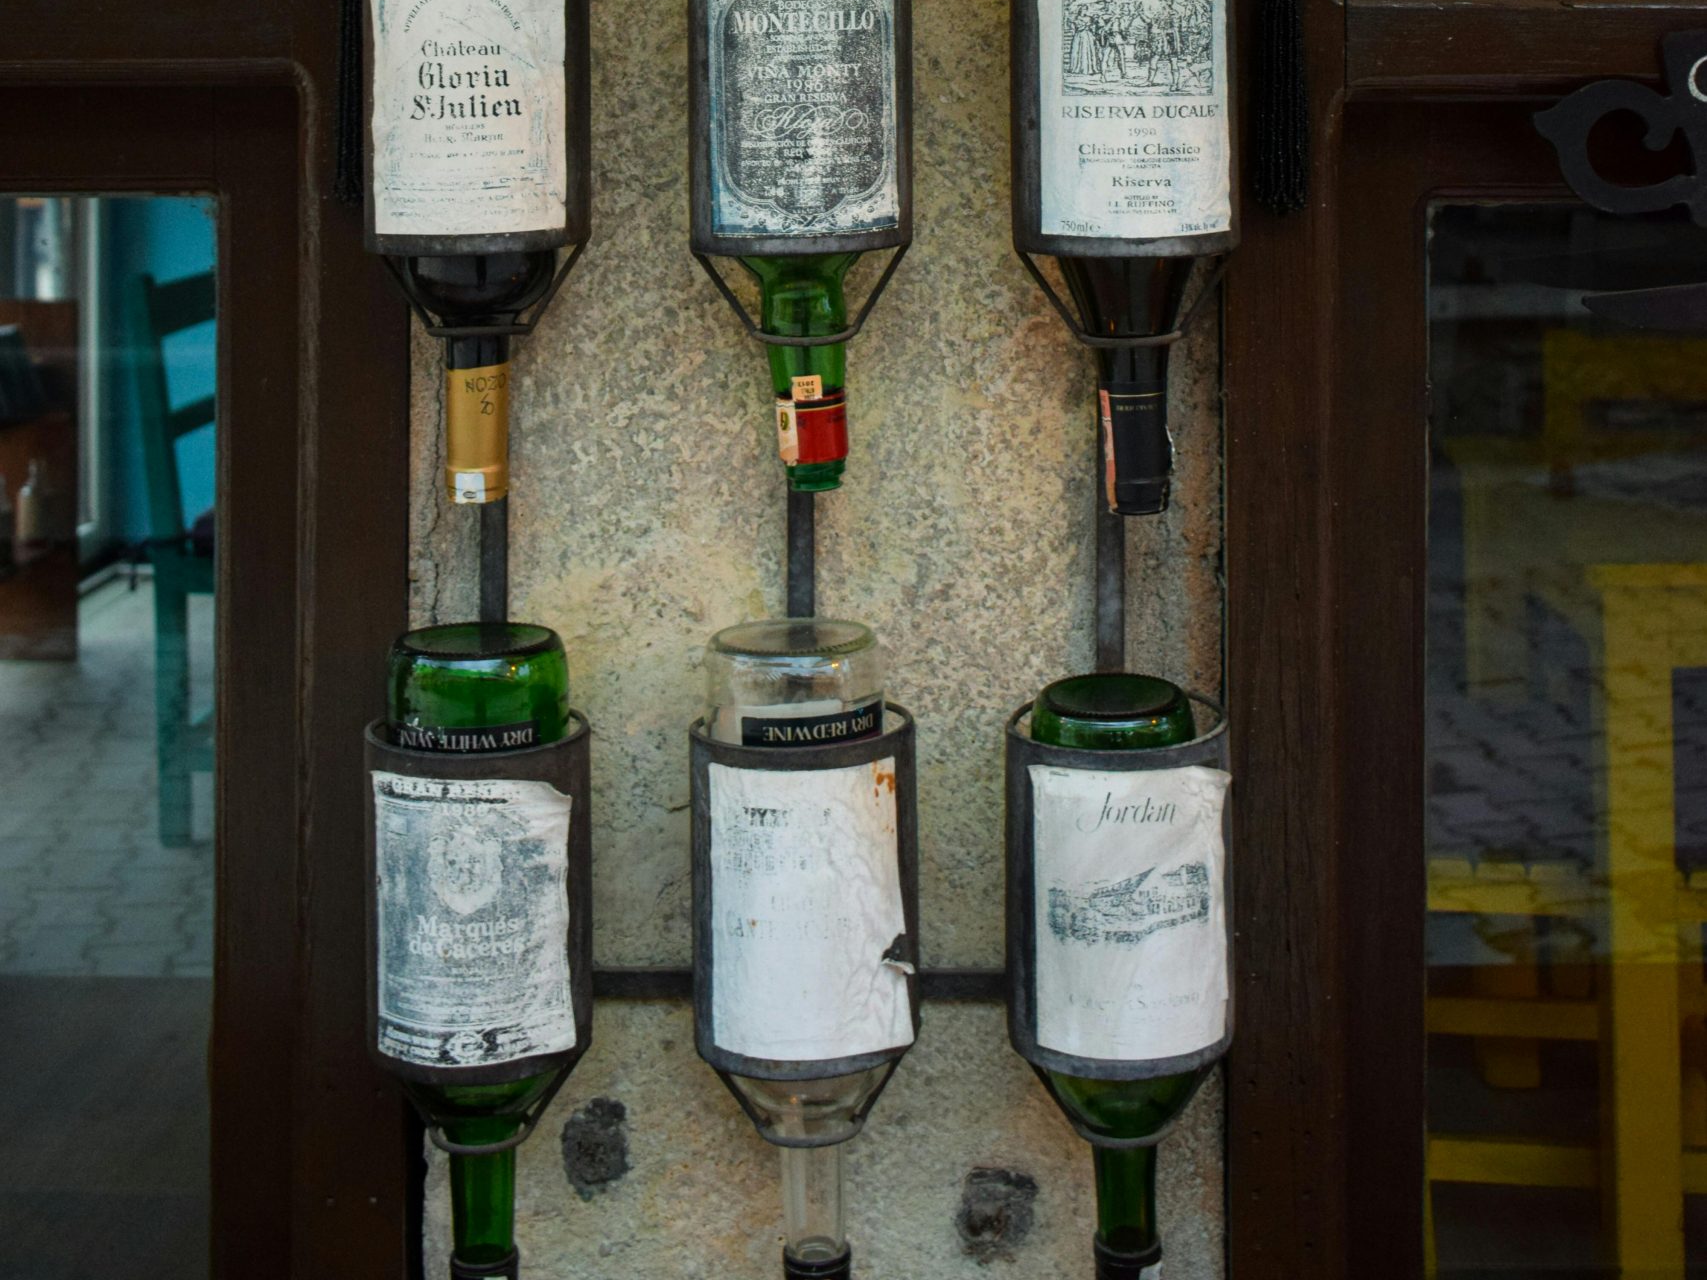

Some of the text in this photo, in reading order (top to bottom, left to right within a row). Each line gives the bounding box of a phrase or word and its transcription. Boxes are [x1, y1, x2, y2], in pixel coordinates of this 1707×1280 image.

[732, 9, 874, 34] MONTECILLO
[421, 39, 501, 57] Château
[418, 61, 510, 89] Gloria
[798, 62, 862, 78] MONTY
[764, 91, 848, 104] GRAN RESERVA
[431, 94, 522, 120] Julien
[1061, 104, 1216, 119] RISERVA DUCALE
[1078, 142, 1201, 155] Chianti Classico
[1111, 175, 1172, 187] Riserva
[762, 712, 874, 741] DRY RED WINE
[438, 732, 497, 750] WHITE
[500, 728, 533, 745] DRY
[1076, 791, 1177, 833] Jordan
[416, 914, 519, 942] Marqués
[409, 935, 434, 956] de
